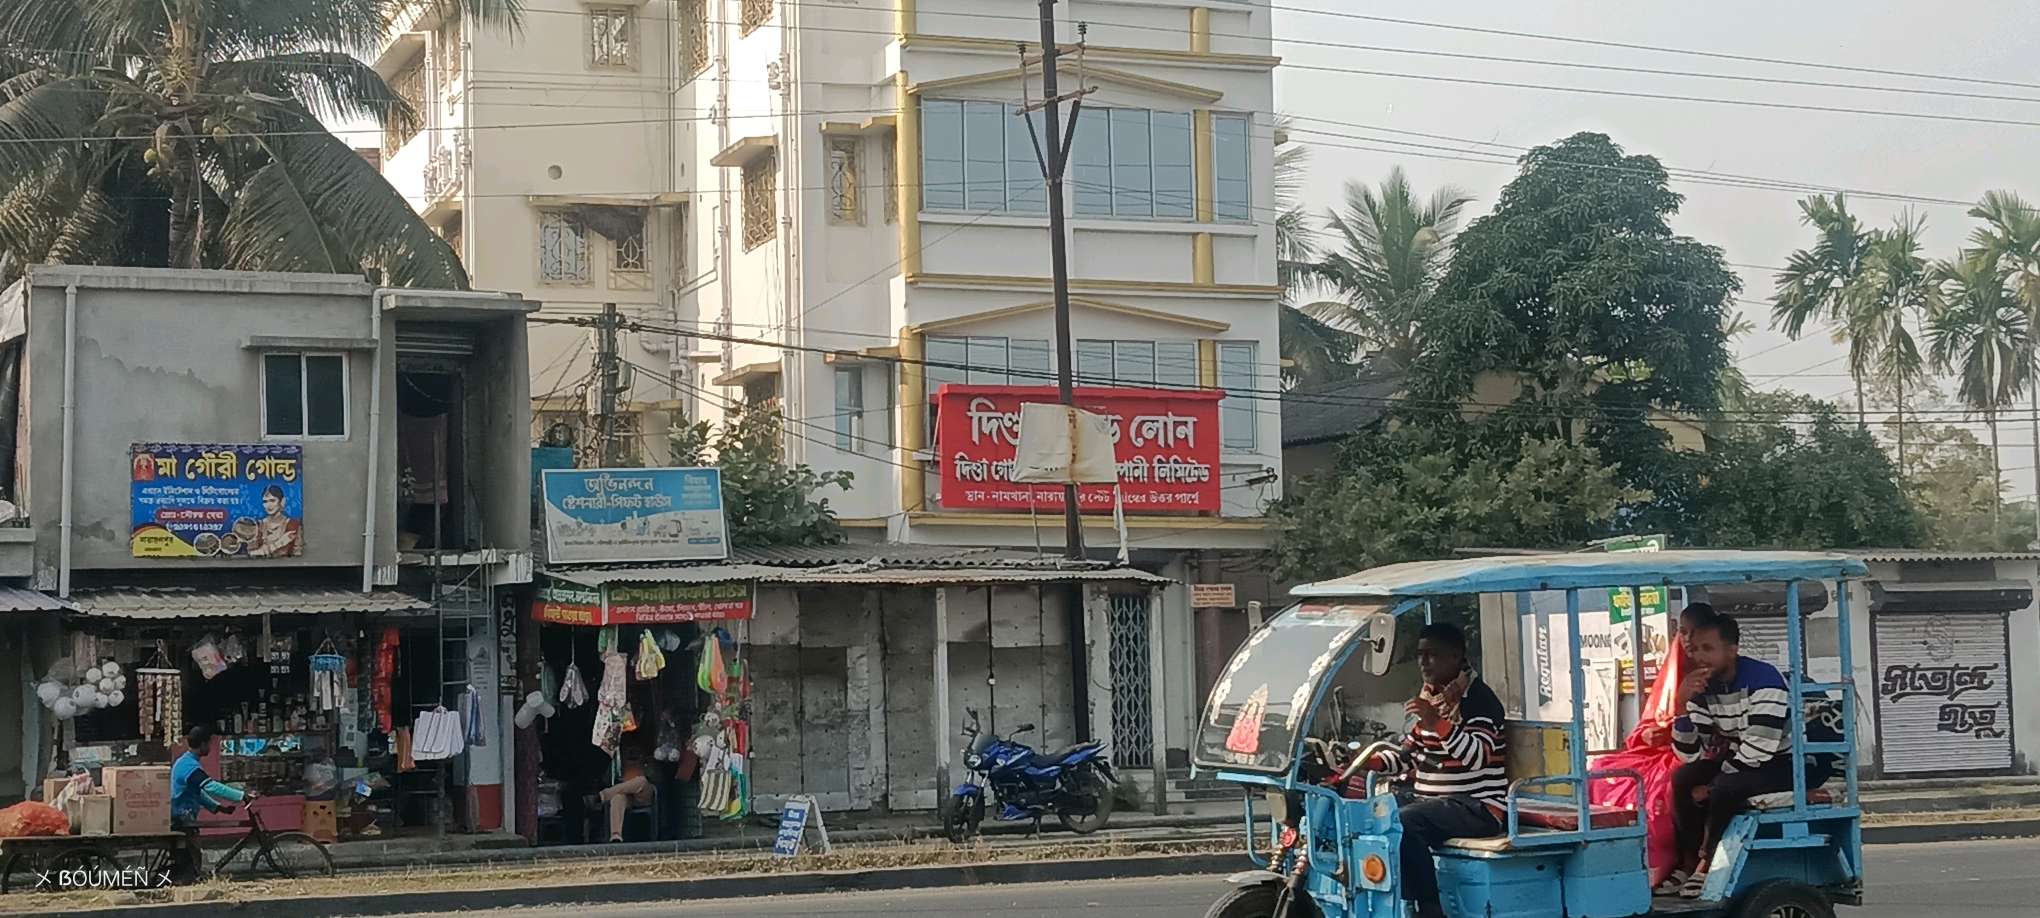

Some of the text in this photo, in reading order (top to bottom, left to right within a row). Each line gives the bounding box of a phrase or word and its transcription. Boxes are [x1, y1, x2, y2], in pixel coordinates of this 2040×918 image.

[1130, 411, 1199, 449] লোন
[155, 451, 297, 482] মা গৌরী গোল্ড
[1153, 455, 1211, 483] লিমিটেড
[584, 473, 655, 494] অভিনন্দন
